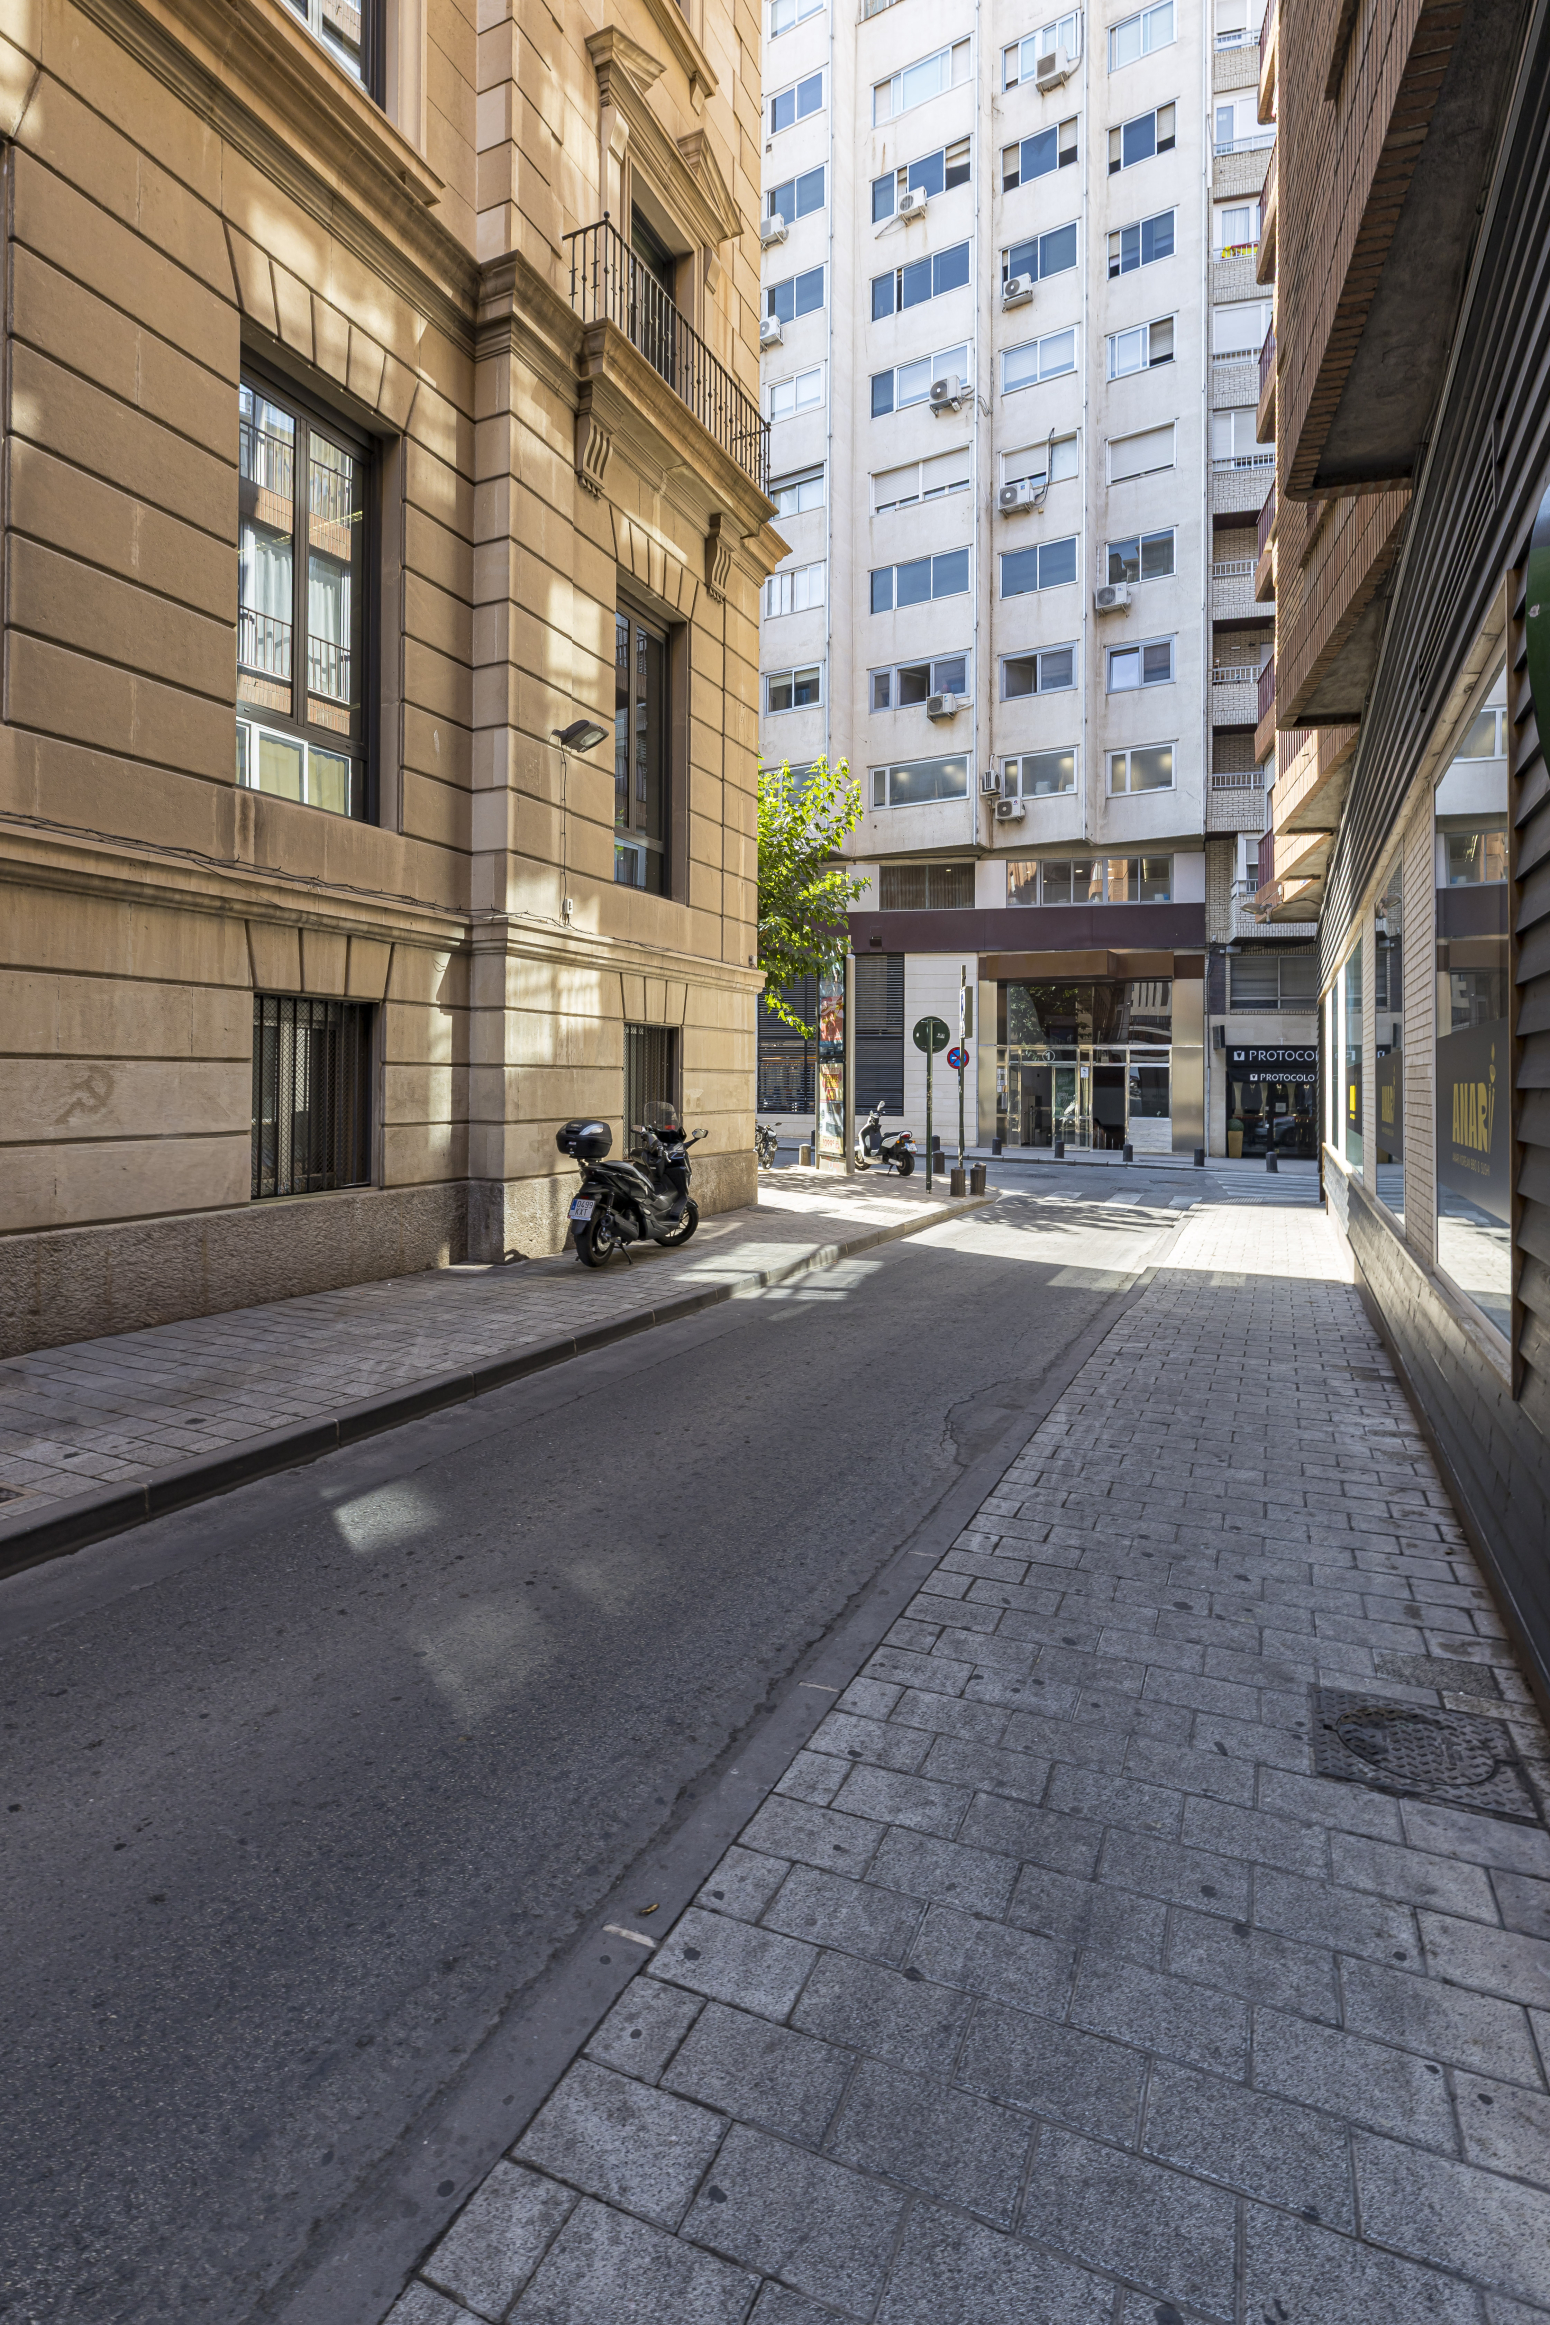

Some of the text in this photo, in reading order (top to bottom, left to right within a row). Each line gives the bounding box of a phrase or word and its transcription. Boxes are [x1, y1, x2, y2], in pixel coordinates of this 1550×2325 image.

[1249, 1050, 1318, 1061] PROTOCO
[1260, 1074, 1315, 1082] PROTOCOLO
[576, 1200, 594, 1209] 0499
[574, 1208, 588, 1216] KXT
